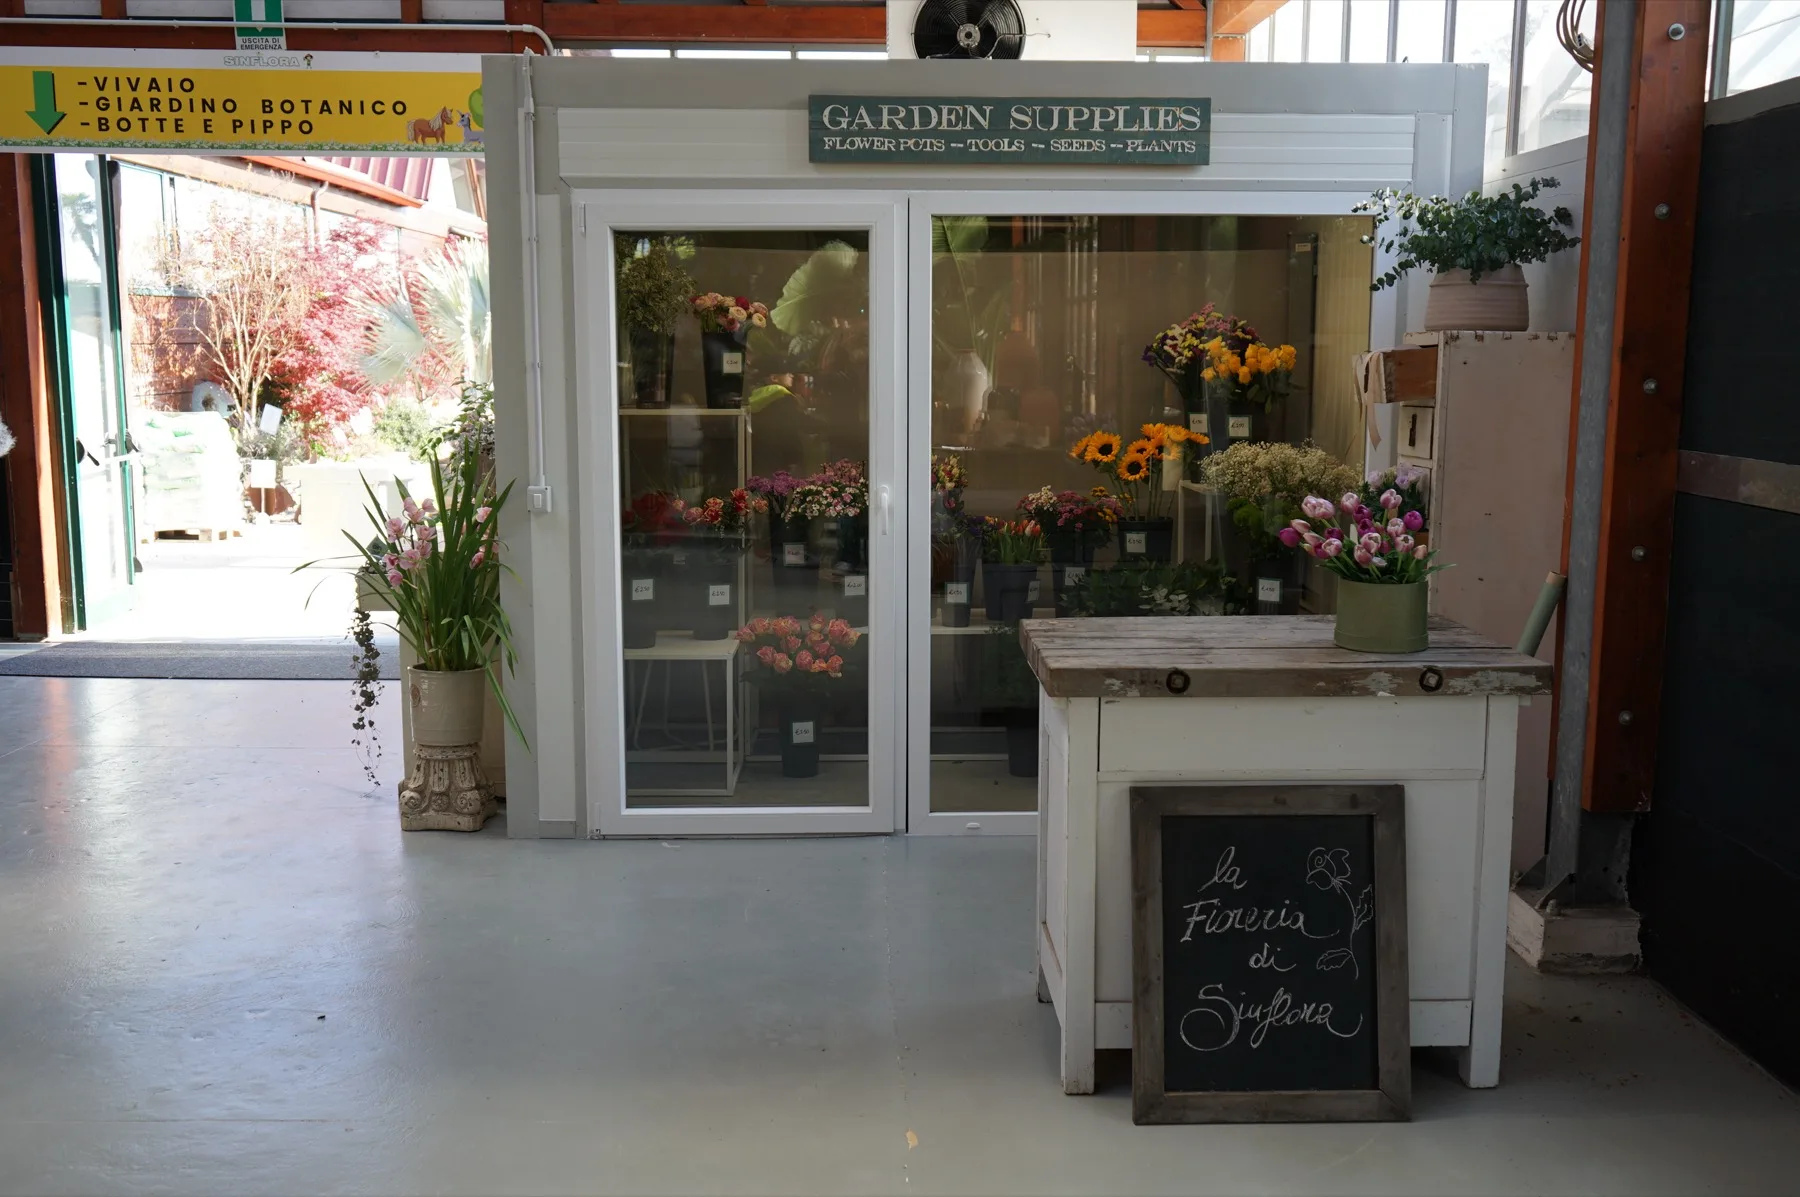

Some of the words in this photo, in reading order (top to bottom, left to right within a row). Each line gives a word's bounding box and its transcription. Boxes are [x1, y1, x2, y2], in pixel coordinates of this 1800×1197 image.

[223, 55, 301, 67] SINFLORA
[261, 98, 407, 116] BOTANICO
[822, 103, 994, 131] GARDEN
[1009, 105, 1201, 132] SUPPLIES
[203, 118, 213, 133] E
[232, 118, 314, 135] PIPPO
[967, 138, 1025, 152] TOOLS
[1050, 138, 1106, 152] SEEDS
[1125, 139, 1197, 153] PLANTS
[1198, 846, 1247, 892] la
[1180, 898, 1340, 942] Fioreria
[1249, 942, 1296, 971] di
